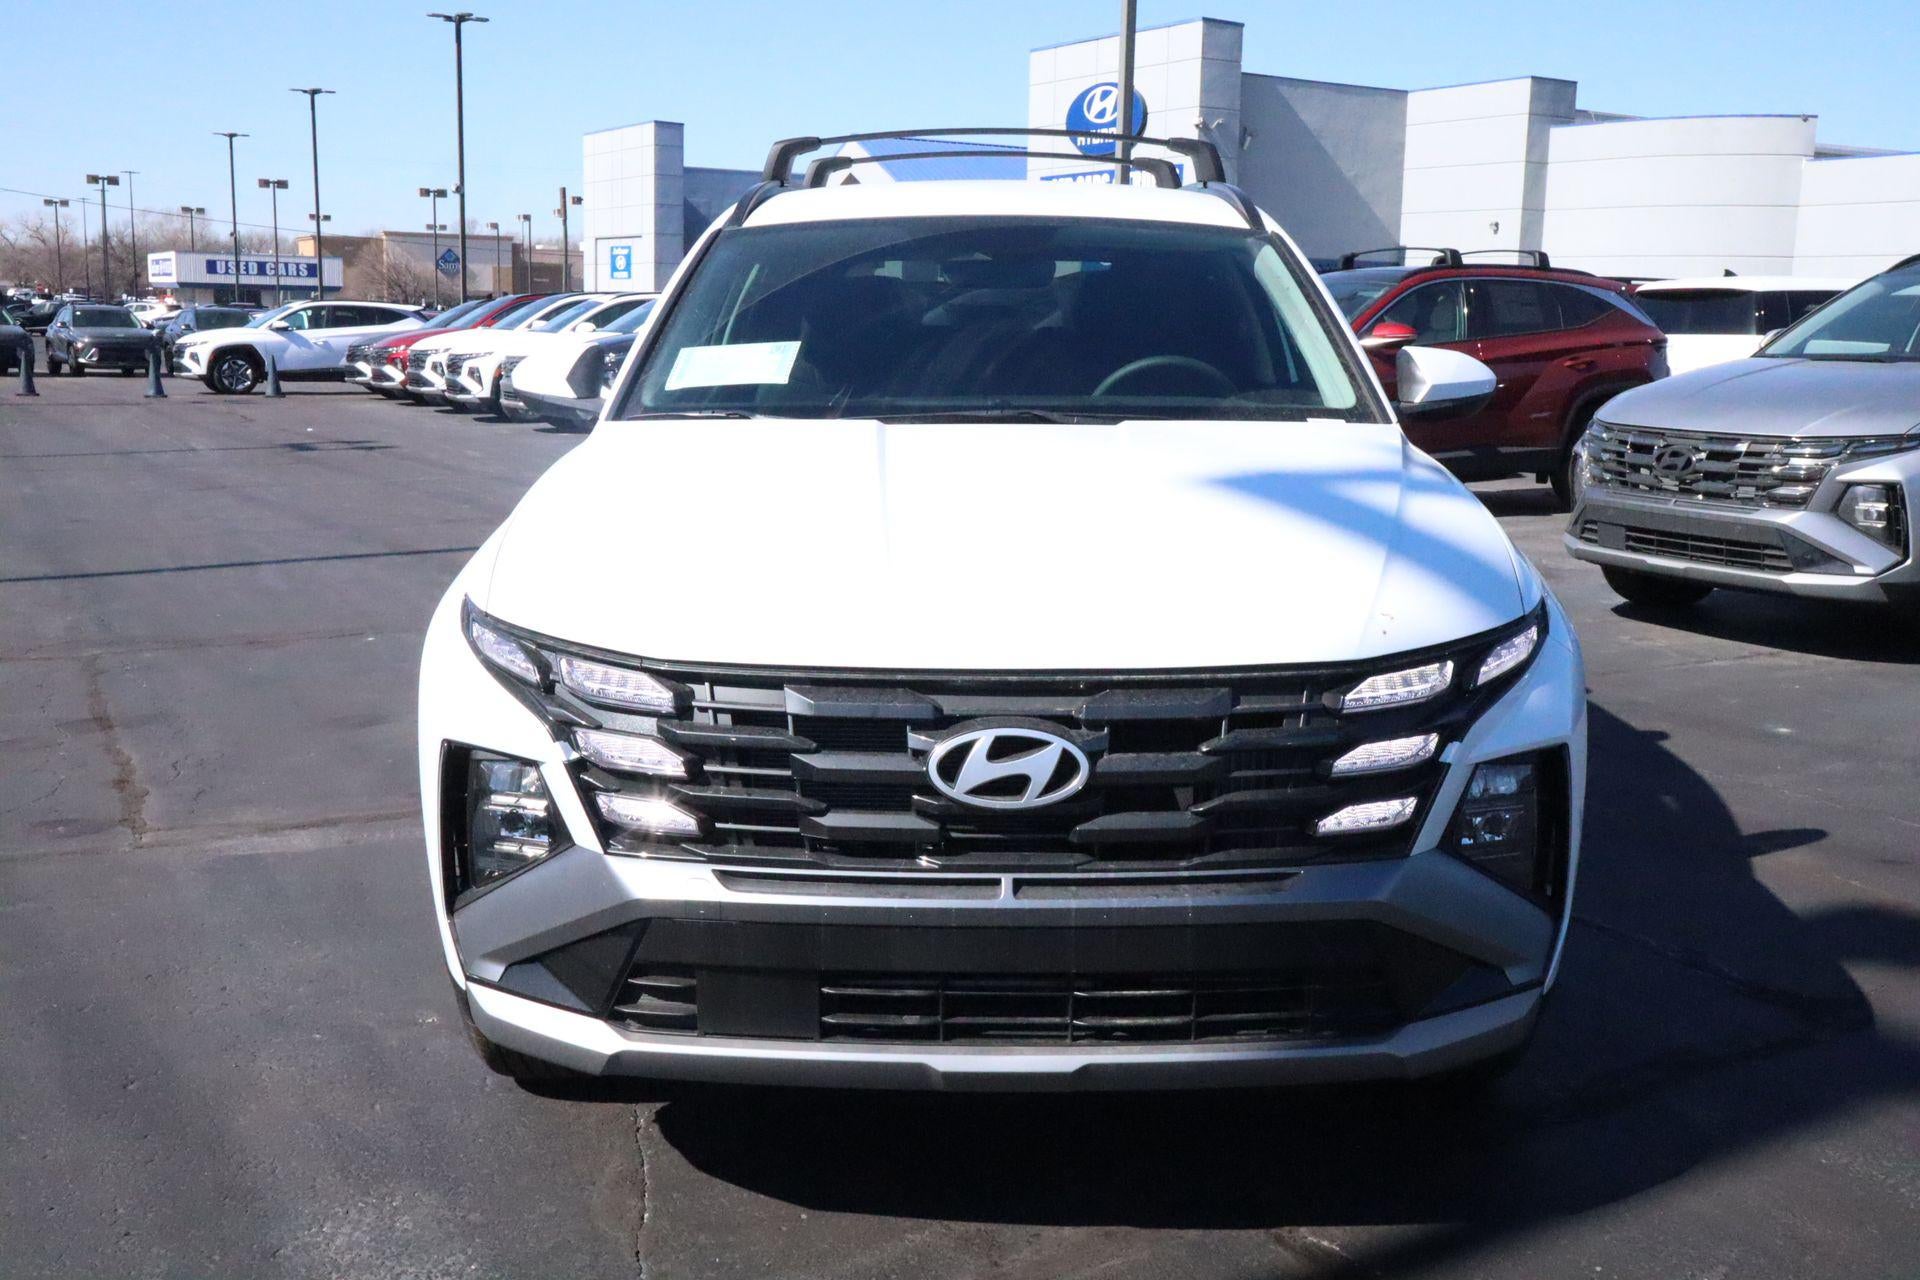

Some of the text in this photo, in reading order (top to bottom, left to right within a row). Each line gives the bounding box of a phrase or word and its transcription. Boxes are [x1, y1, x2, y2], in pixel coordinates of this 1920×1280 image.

[216, 260, 308, 277] USED CARS
[438, 259, 458, 270] Sam
